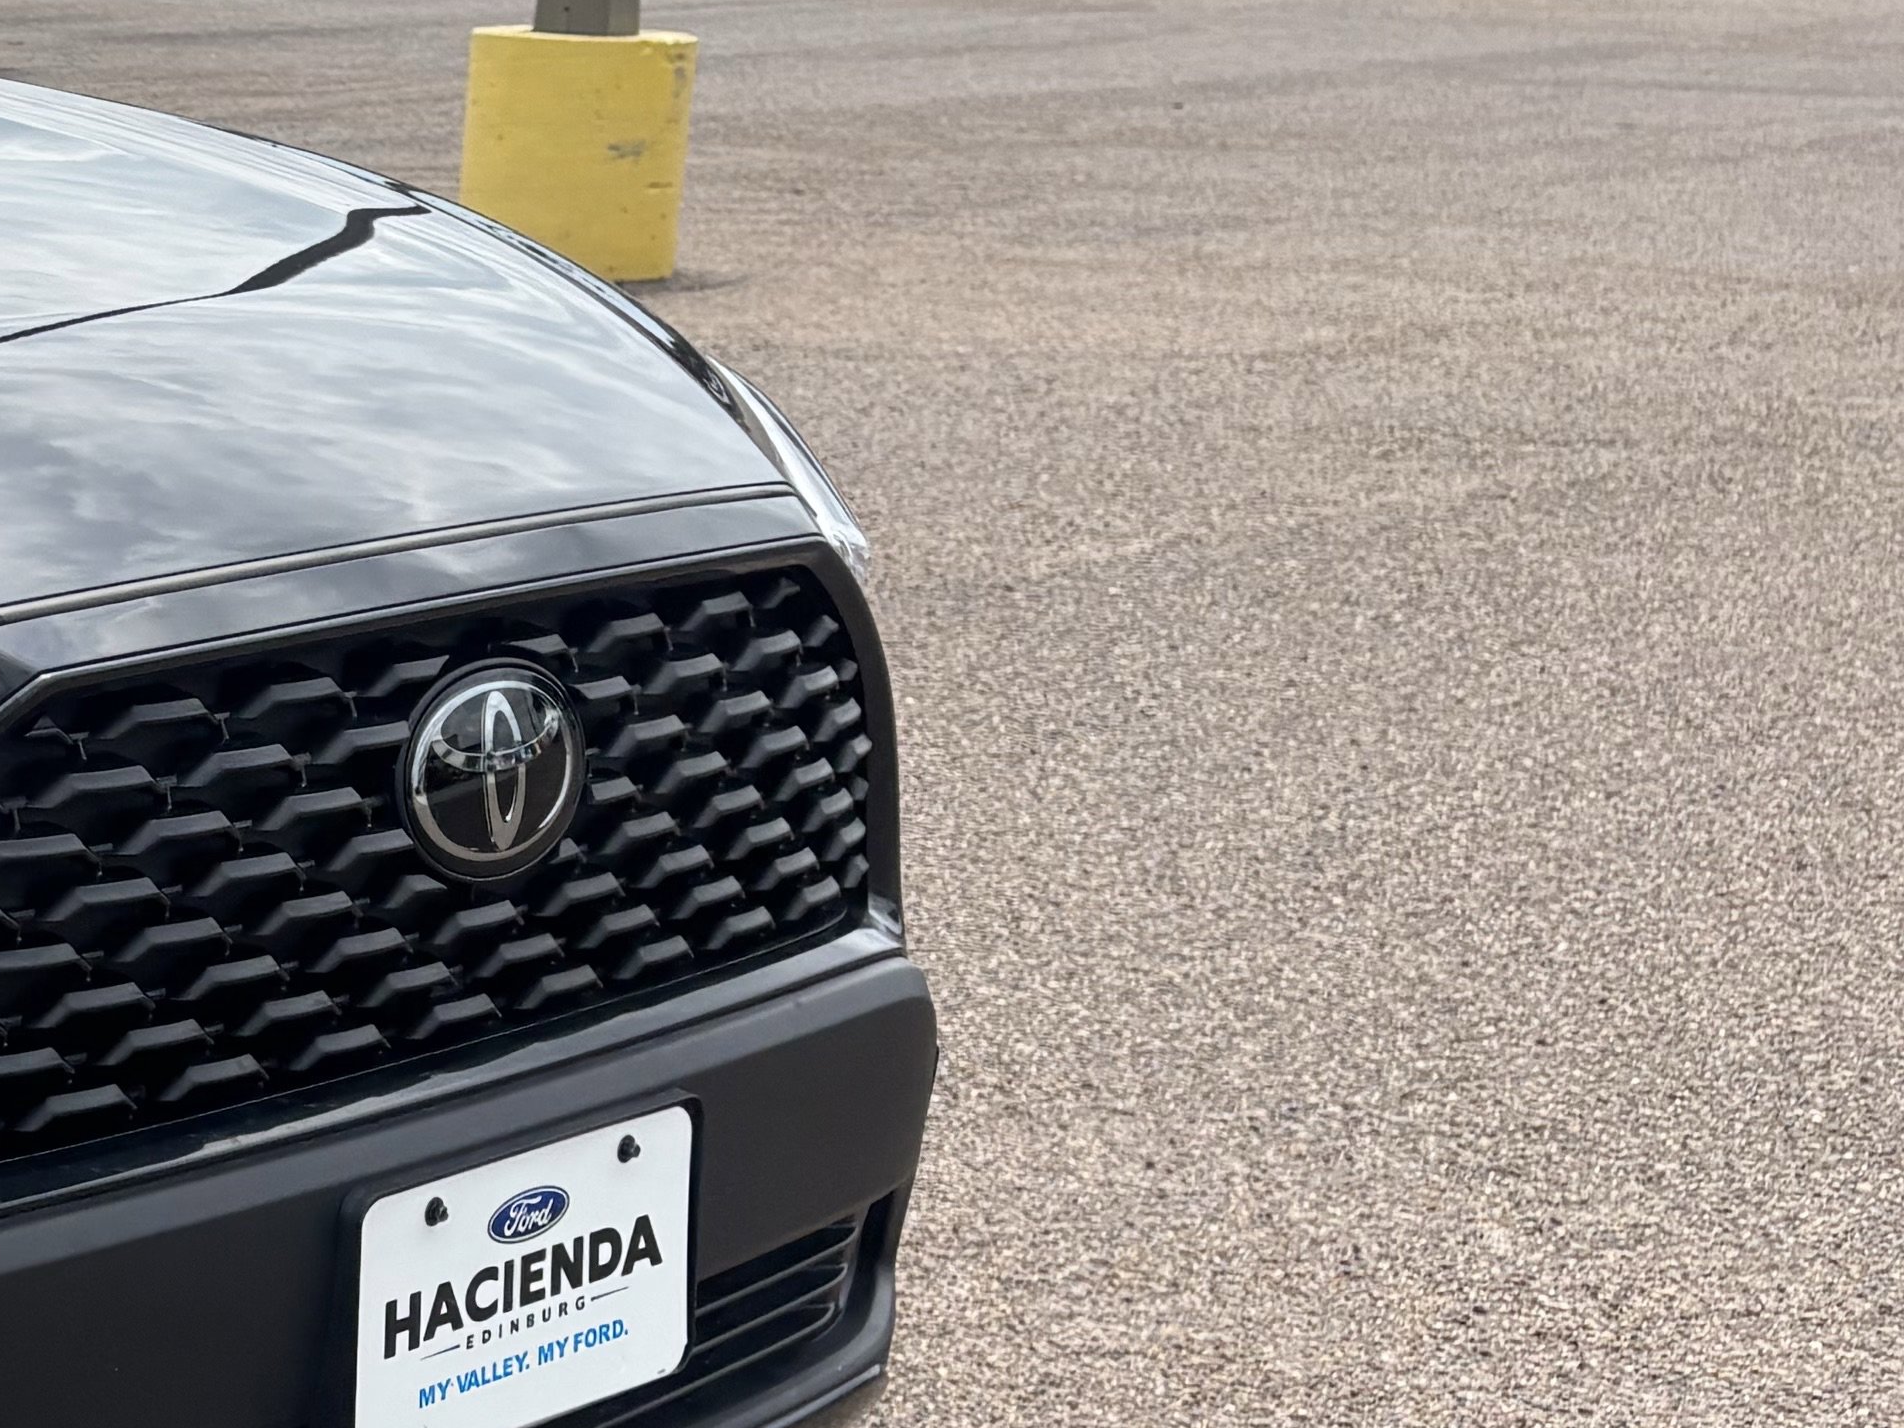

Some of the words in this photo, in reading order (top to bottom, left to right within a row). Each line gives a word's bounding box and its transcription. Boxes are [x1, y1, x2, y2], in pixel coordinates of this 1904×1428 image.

[504, 1196, 553, 1237] Ford
[383, 1214, 663, 1360] HACIENDA
[465, 1295, 586, 1350] EDINBURG
[419, 1380, 453, 1409] MY
[456, 1351, 530, 1393] VALLEY.
[538, 1336, 570, 1364] MY
[574, 1318, 629, 1353] FORD.
